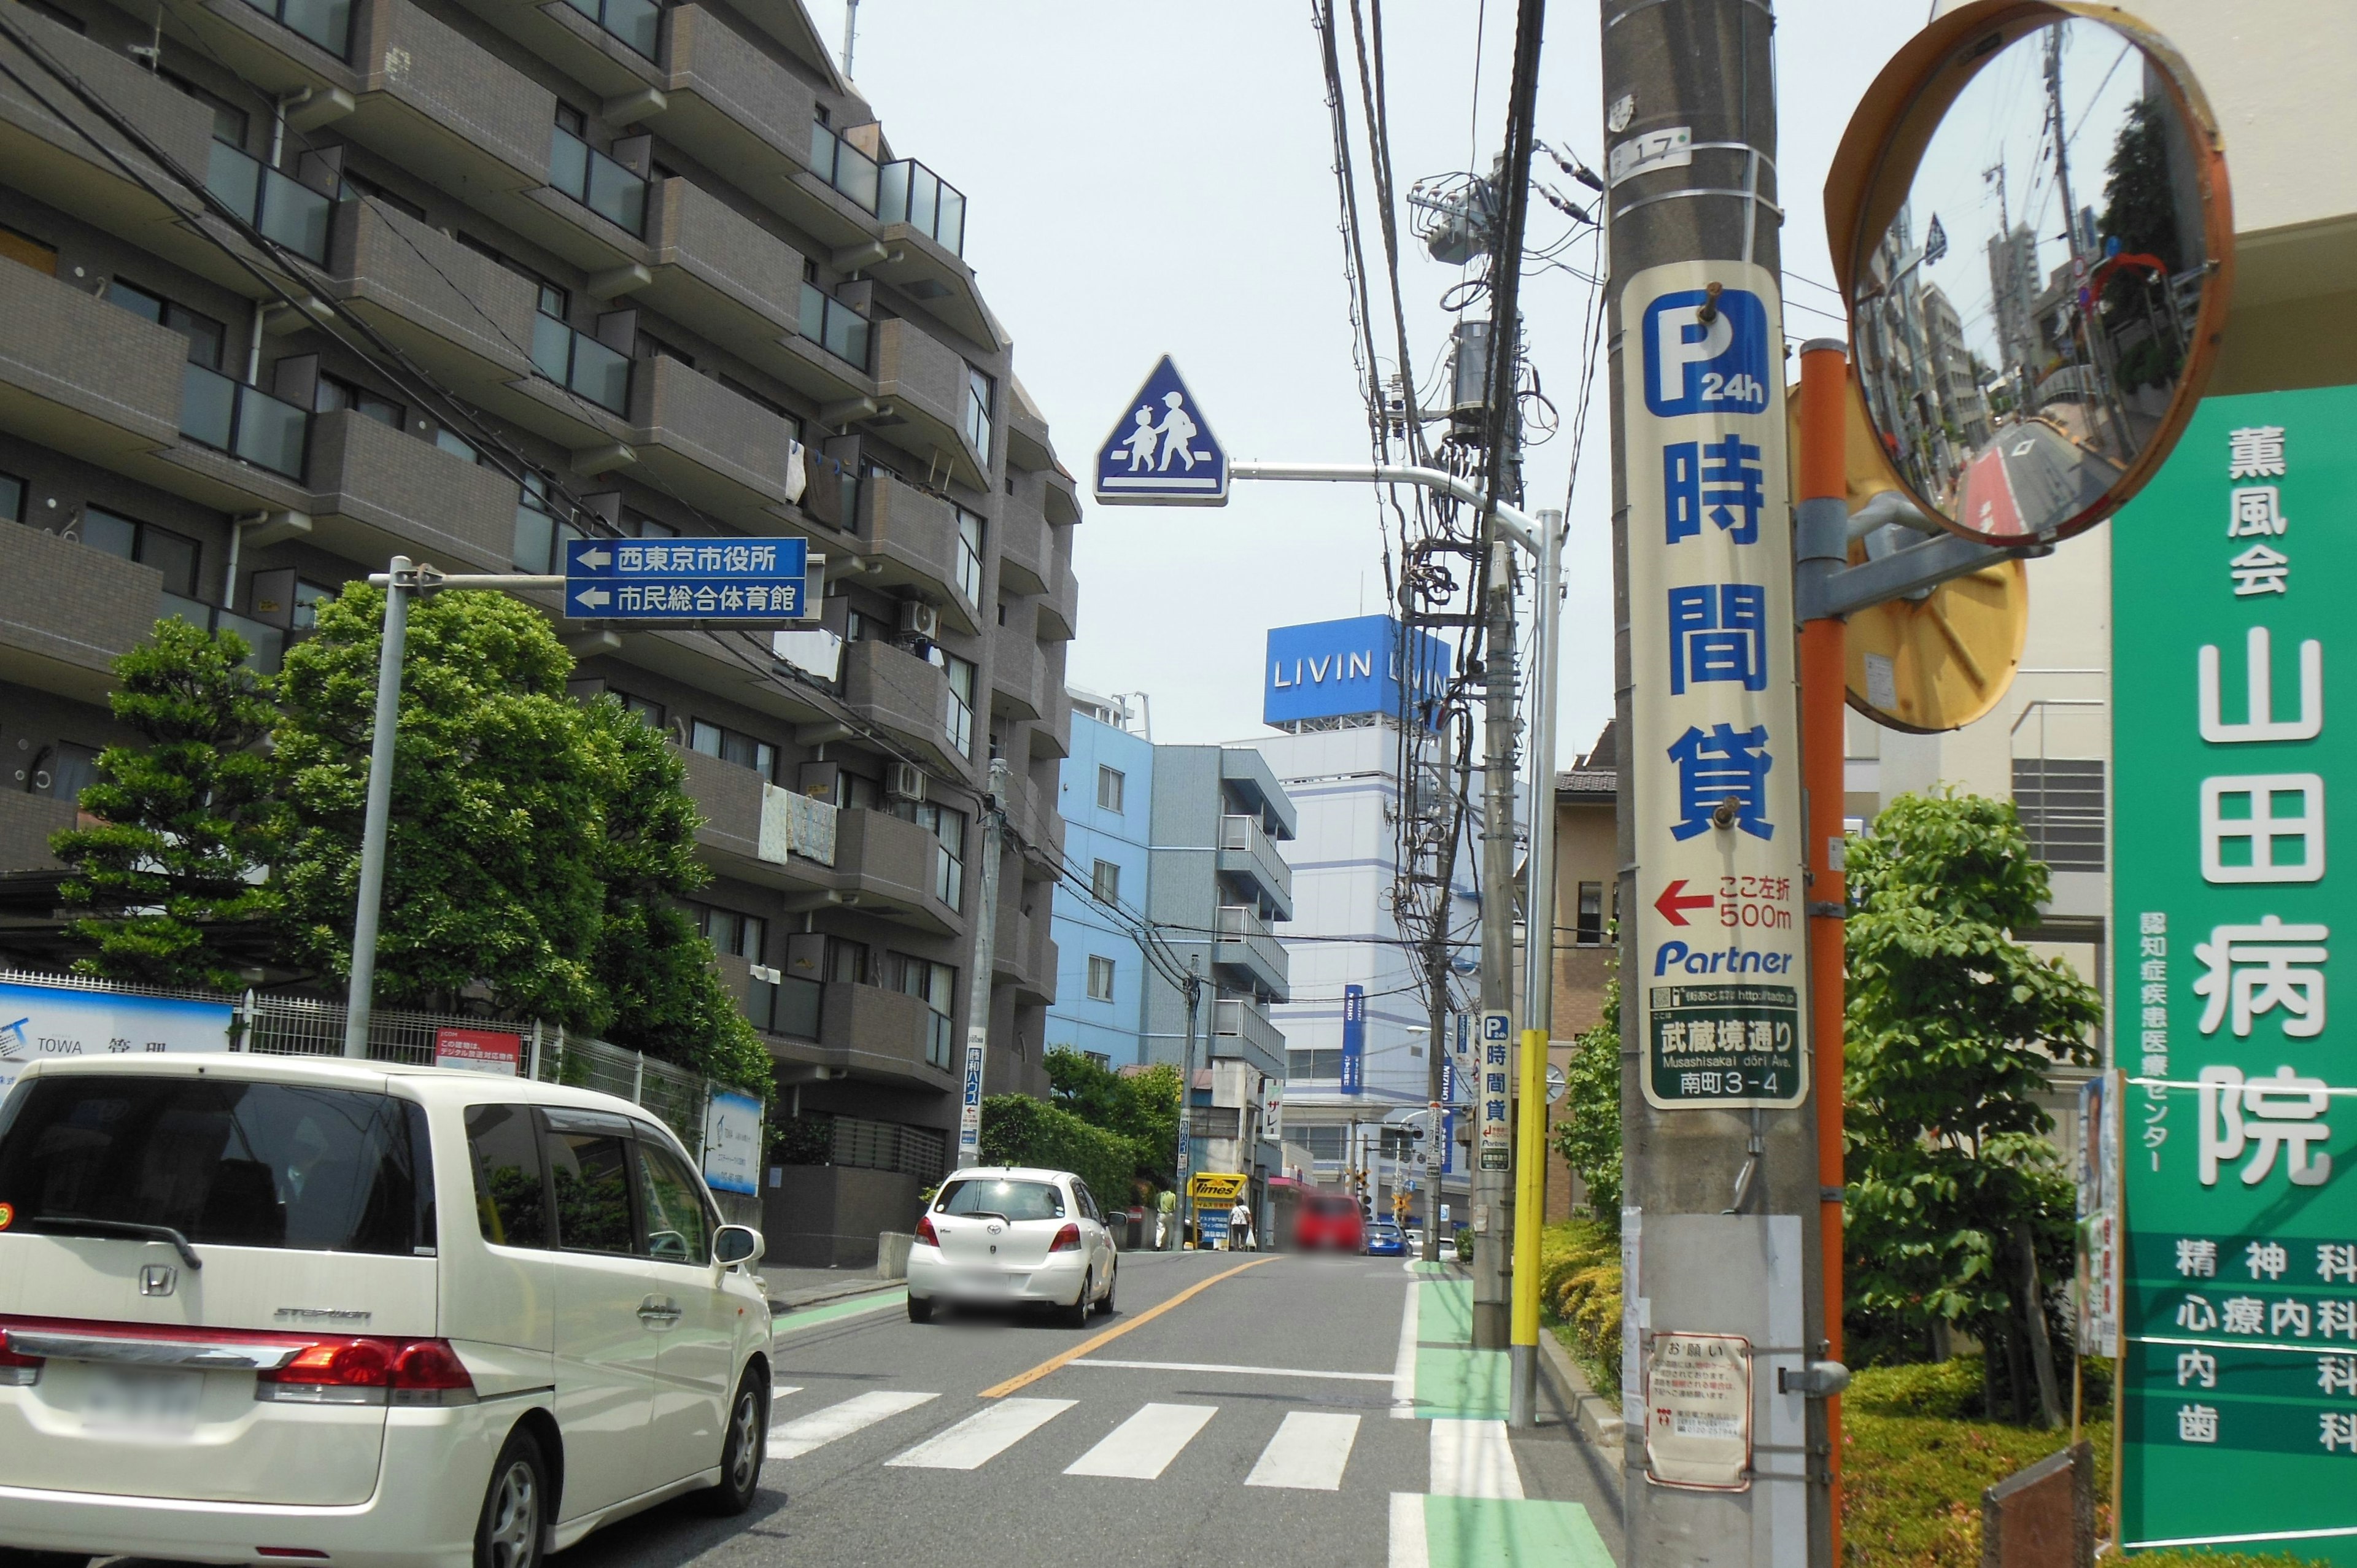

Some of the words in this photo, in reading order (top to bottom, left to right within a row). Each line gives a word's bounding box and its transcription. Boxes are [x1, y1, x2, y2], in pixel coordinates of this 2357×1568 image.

[1658, 306, 1733, 402] P
[1701, 373, 1763, 404] 24h
[2227, 426, 2288, 596] 薫風会
[618, 546, 776, 572] 西東京市役所
[617, 585, 796, 611] 市民総合体育館
[1663, 434, 1775, 842] 時間貸
[1274, 650, 1371, 687] LIVIN
[1720, 875, 1790, 902] ここ左折
[2194, 626, 2331, 1186] 山田病院
[1720, 904, 1792, 930] 500m
[1654, 940, 1792, 976] Partner
[38, 1038, 82, 1054] TOWA
[1486, 1019, 1501, 1037] P
[1661, 1021, 1792, 1054] 武蔵境通り
[2140, 912, 2168, 1172] 認知症疾患医療センター
[1663, 1055, 1737, 1068] Musashisakai
[1486, 1045, 1506, 1121] 時間貸
[2176, 1238, 2357, 1283] 精神科
[2177, 1294, 2357, 1339] 心療内科
[1668, 1342, 1723, 1358] お願い
[2177, 1350, 2357, 1396] 内科
[2178, 1404, 2357, 1452] 歯科
